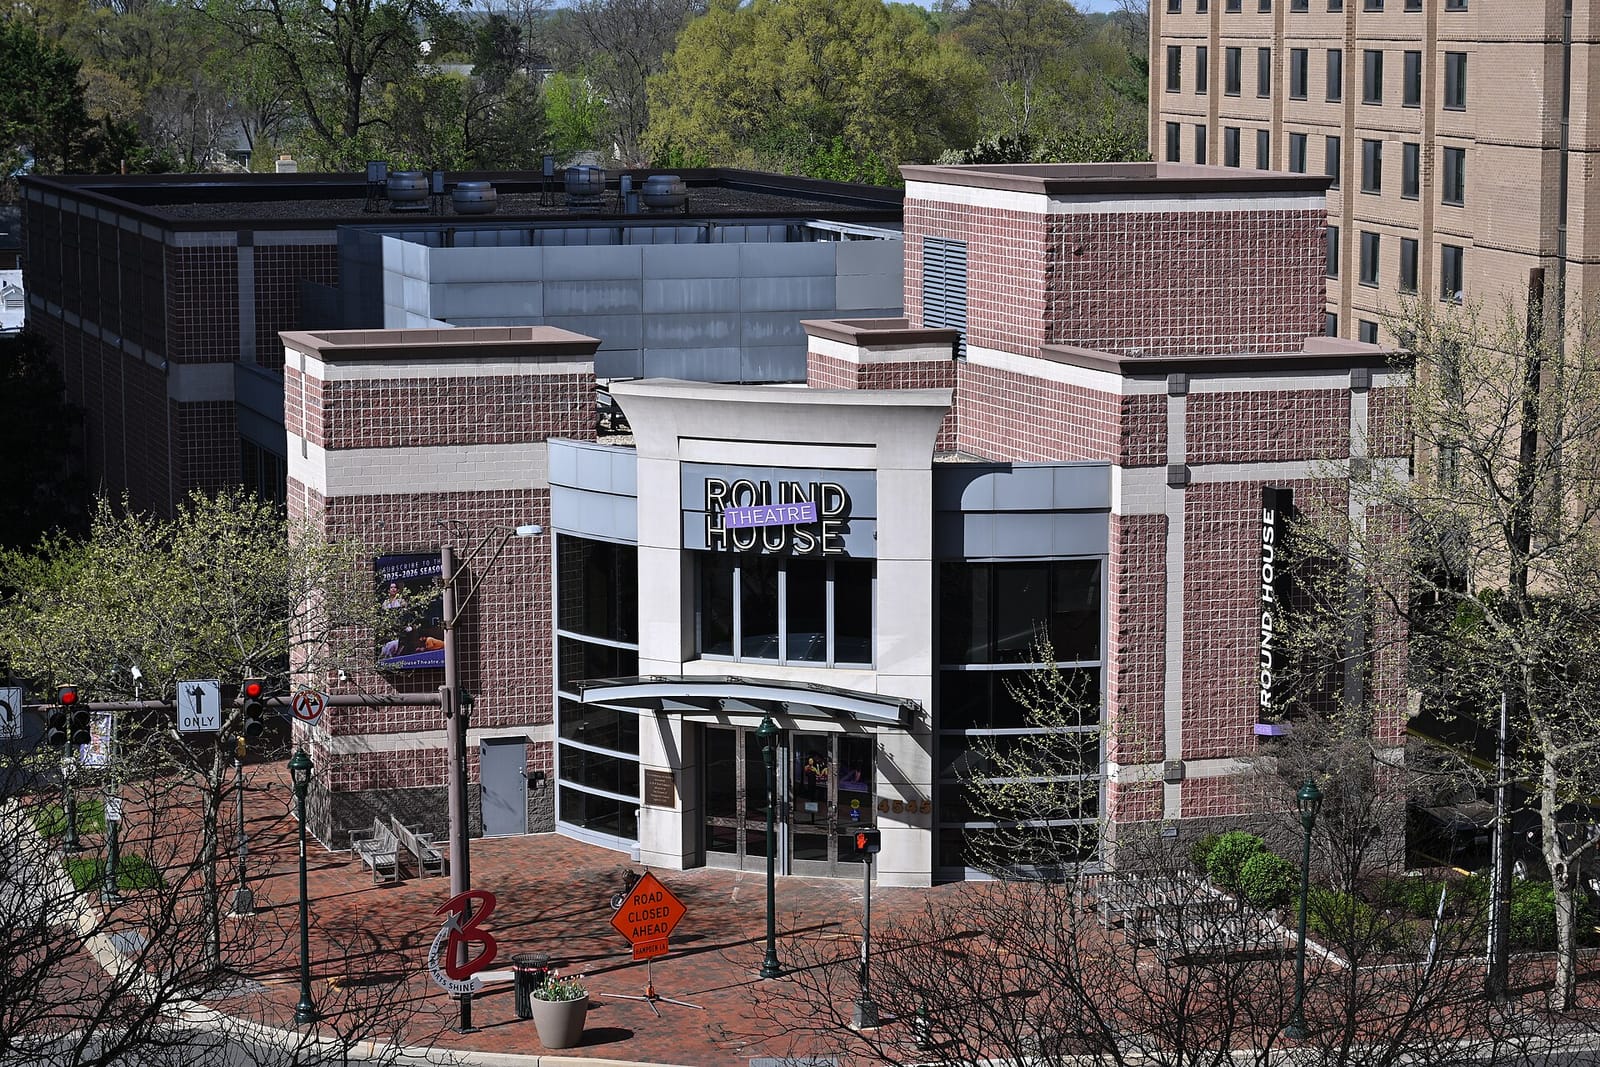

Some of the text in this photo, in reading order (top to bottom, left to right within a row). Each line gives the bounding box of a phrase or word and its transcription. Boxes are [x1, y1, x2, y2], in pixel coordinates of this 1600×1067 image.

[705, 478, 850, 516] ROUND
[729, 505, 812, 525] THEATRE
[705, 514, 843, 553] HOUSE
[383, 564, 443, 581] 2025-2026 SEASO
[1261, 508, 1274, 708] ROUND HOUSE
[184, 716, 214, 727] ONLY
[878, 799, 932, 815] 4545
[633, 891, 663, 906] ROAD
[628, 906, 670, 923] CLOSED
[632, 922, 668, 938] AHEAD
[431, 968, 448, 986] ARTS
[448, 981, 475, 992] SHINE
